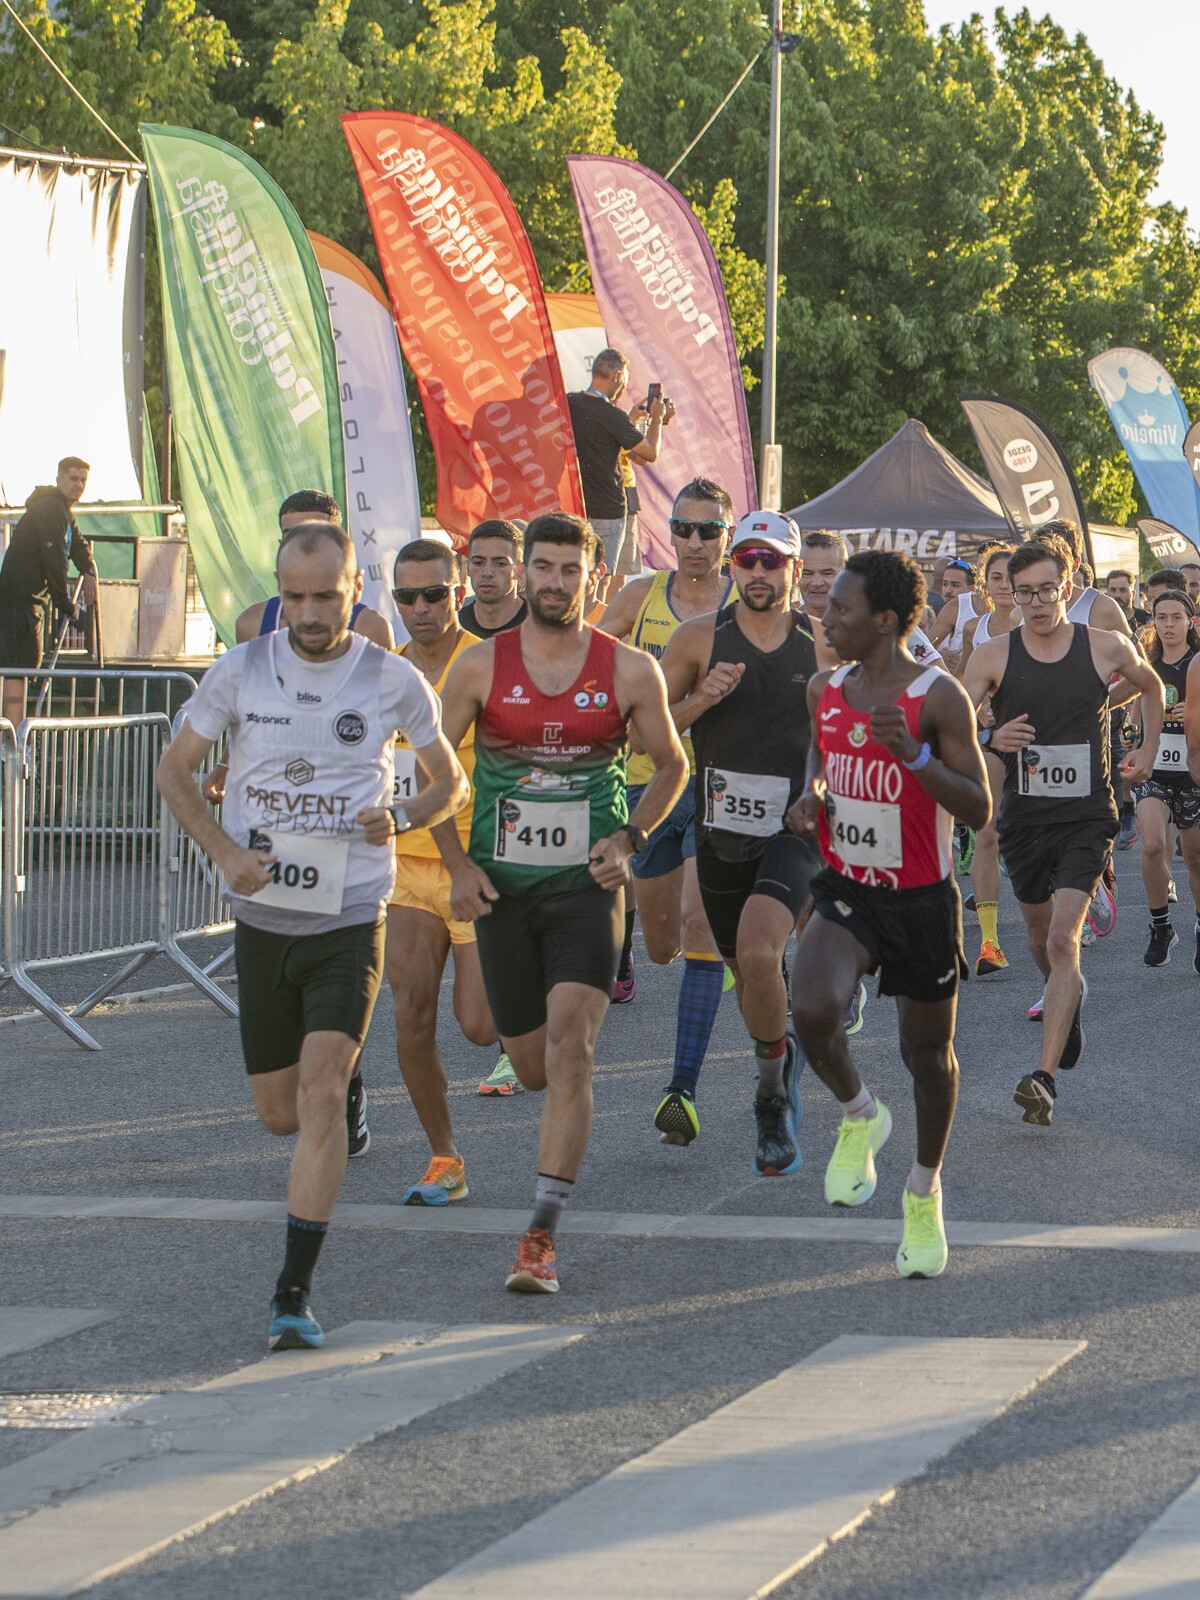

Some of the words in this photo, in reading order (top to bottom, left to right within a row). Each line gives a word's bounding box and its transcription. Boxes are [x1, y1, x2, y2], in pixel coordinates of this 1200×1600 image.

[503, 697, 531, 705] VIATOR
[338, 726, 362, 736] TEJO
[1162, 750, 1181, 762] 90
[1039, 767, 1077, 784] 100
[246, 785, 352, 816] PREVENT
[725, 795, 767, 819] 355
[518, 826, 567, 847] 410
[836, 822, 877, 847] 404
[268, 861, 320, 889] 409
